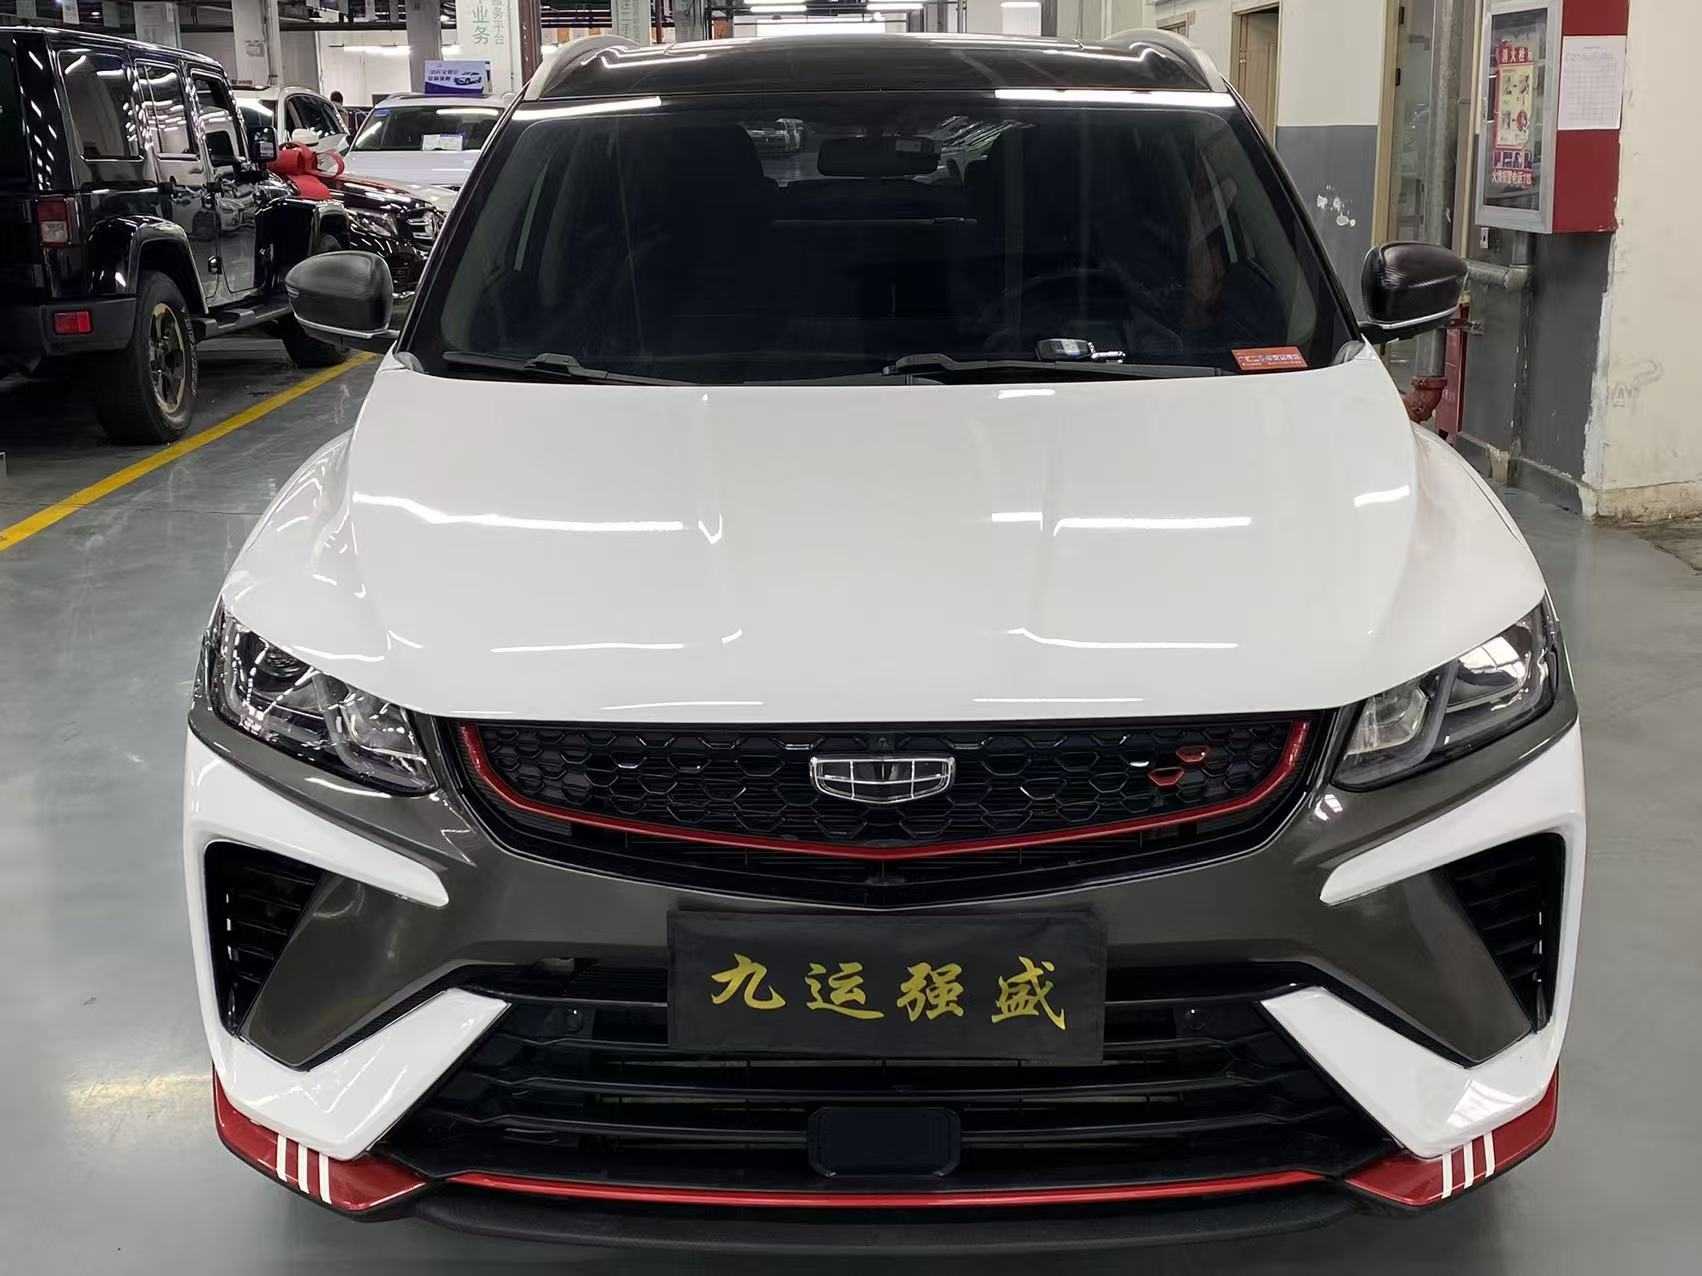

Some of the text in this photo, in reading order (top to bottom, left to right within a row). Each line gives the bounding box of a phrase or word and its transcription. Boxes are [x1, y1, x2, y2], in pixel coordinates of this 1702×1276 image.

[472, 0, 490, 45] 业务
[711, 952, 1067, 1031] 九运强盛
